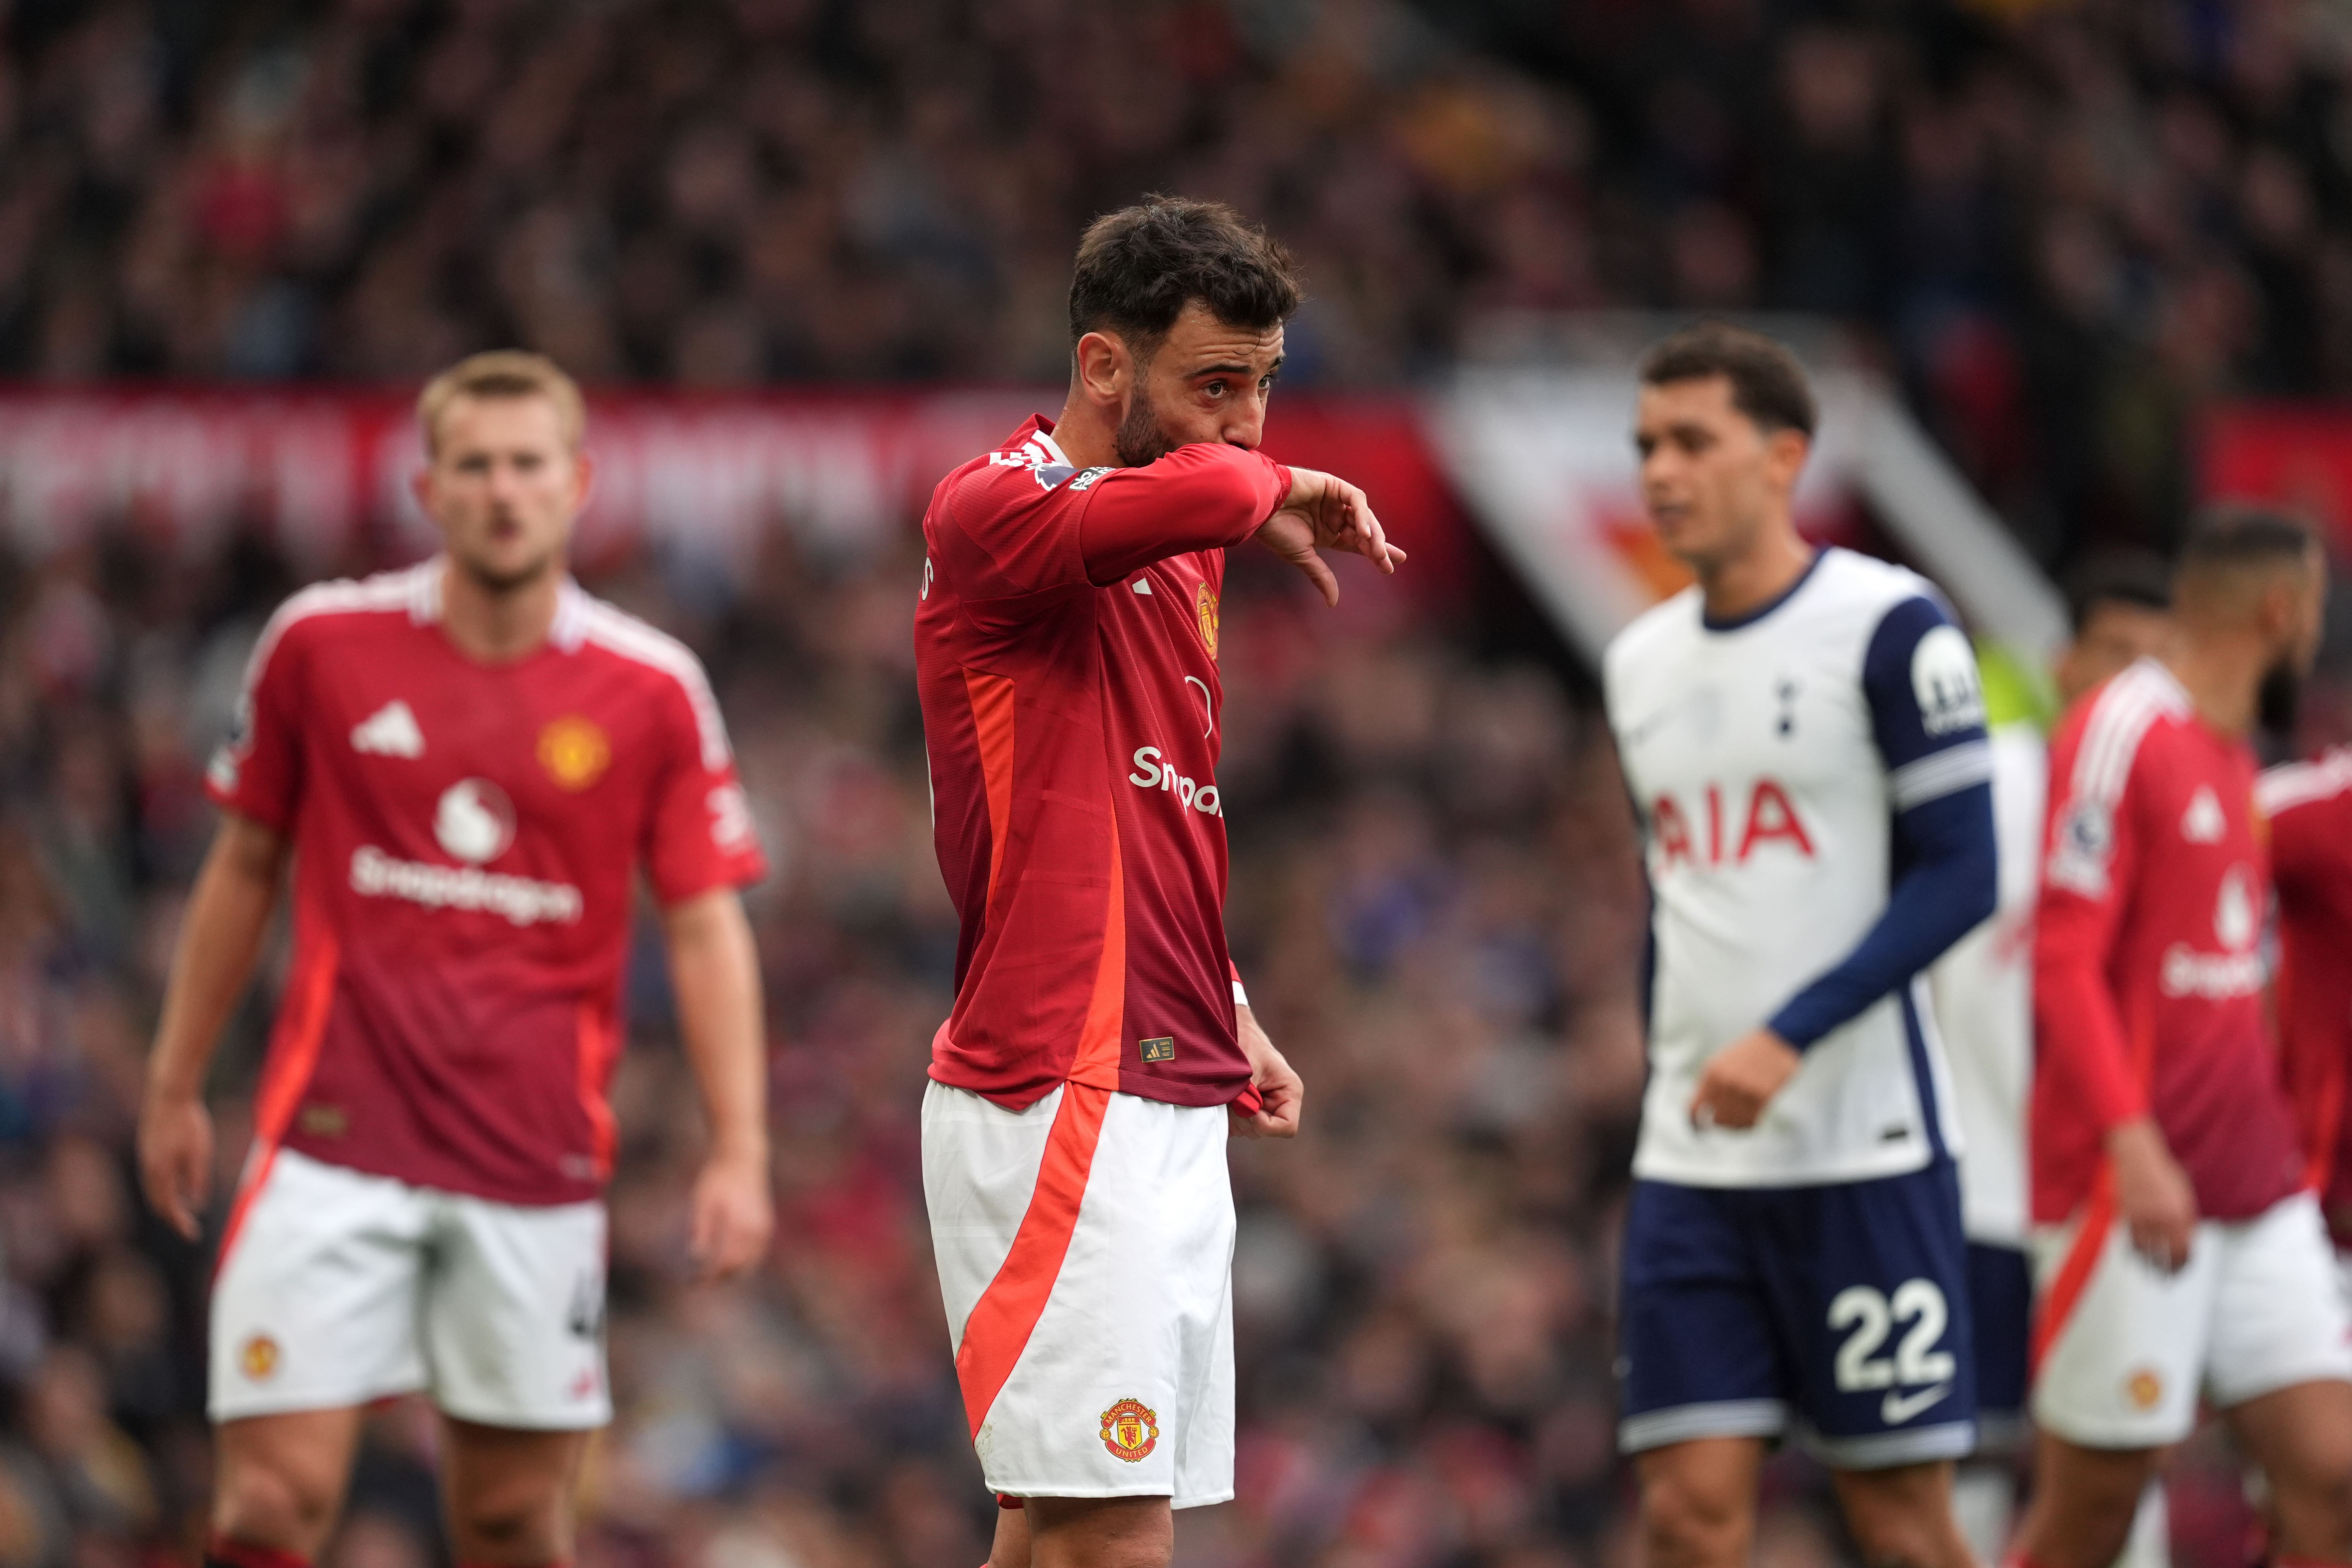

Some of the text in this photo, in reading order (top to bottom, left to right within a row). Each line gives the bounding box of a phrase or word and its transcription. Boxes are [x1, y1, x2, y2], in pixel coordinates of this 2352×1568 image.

[1069, 472, 1092, 490] No
[1652, 777, 1816, 872] AIA
[1827, 1278, 1956, 1393] 22
[1105, 1403, 1152, 1424] MANCHESTER
[1116, 1446, 1148, 1457] UNITED
